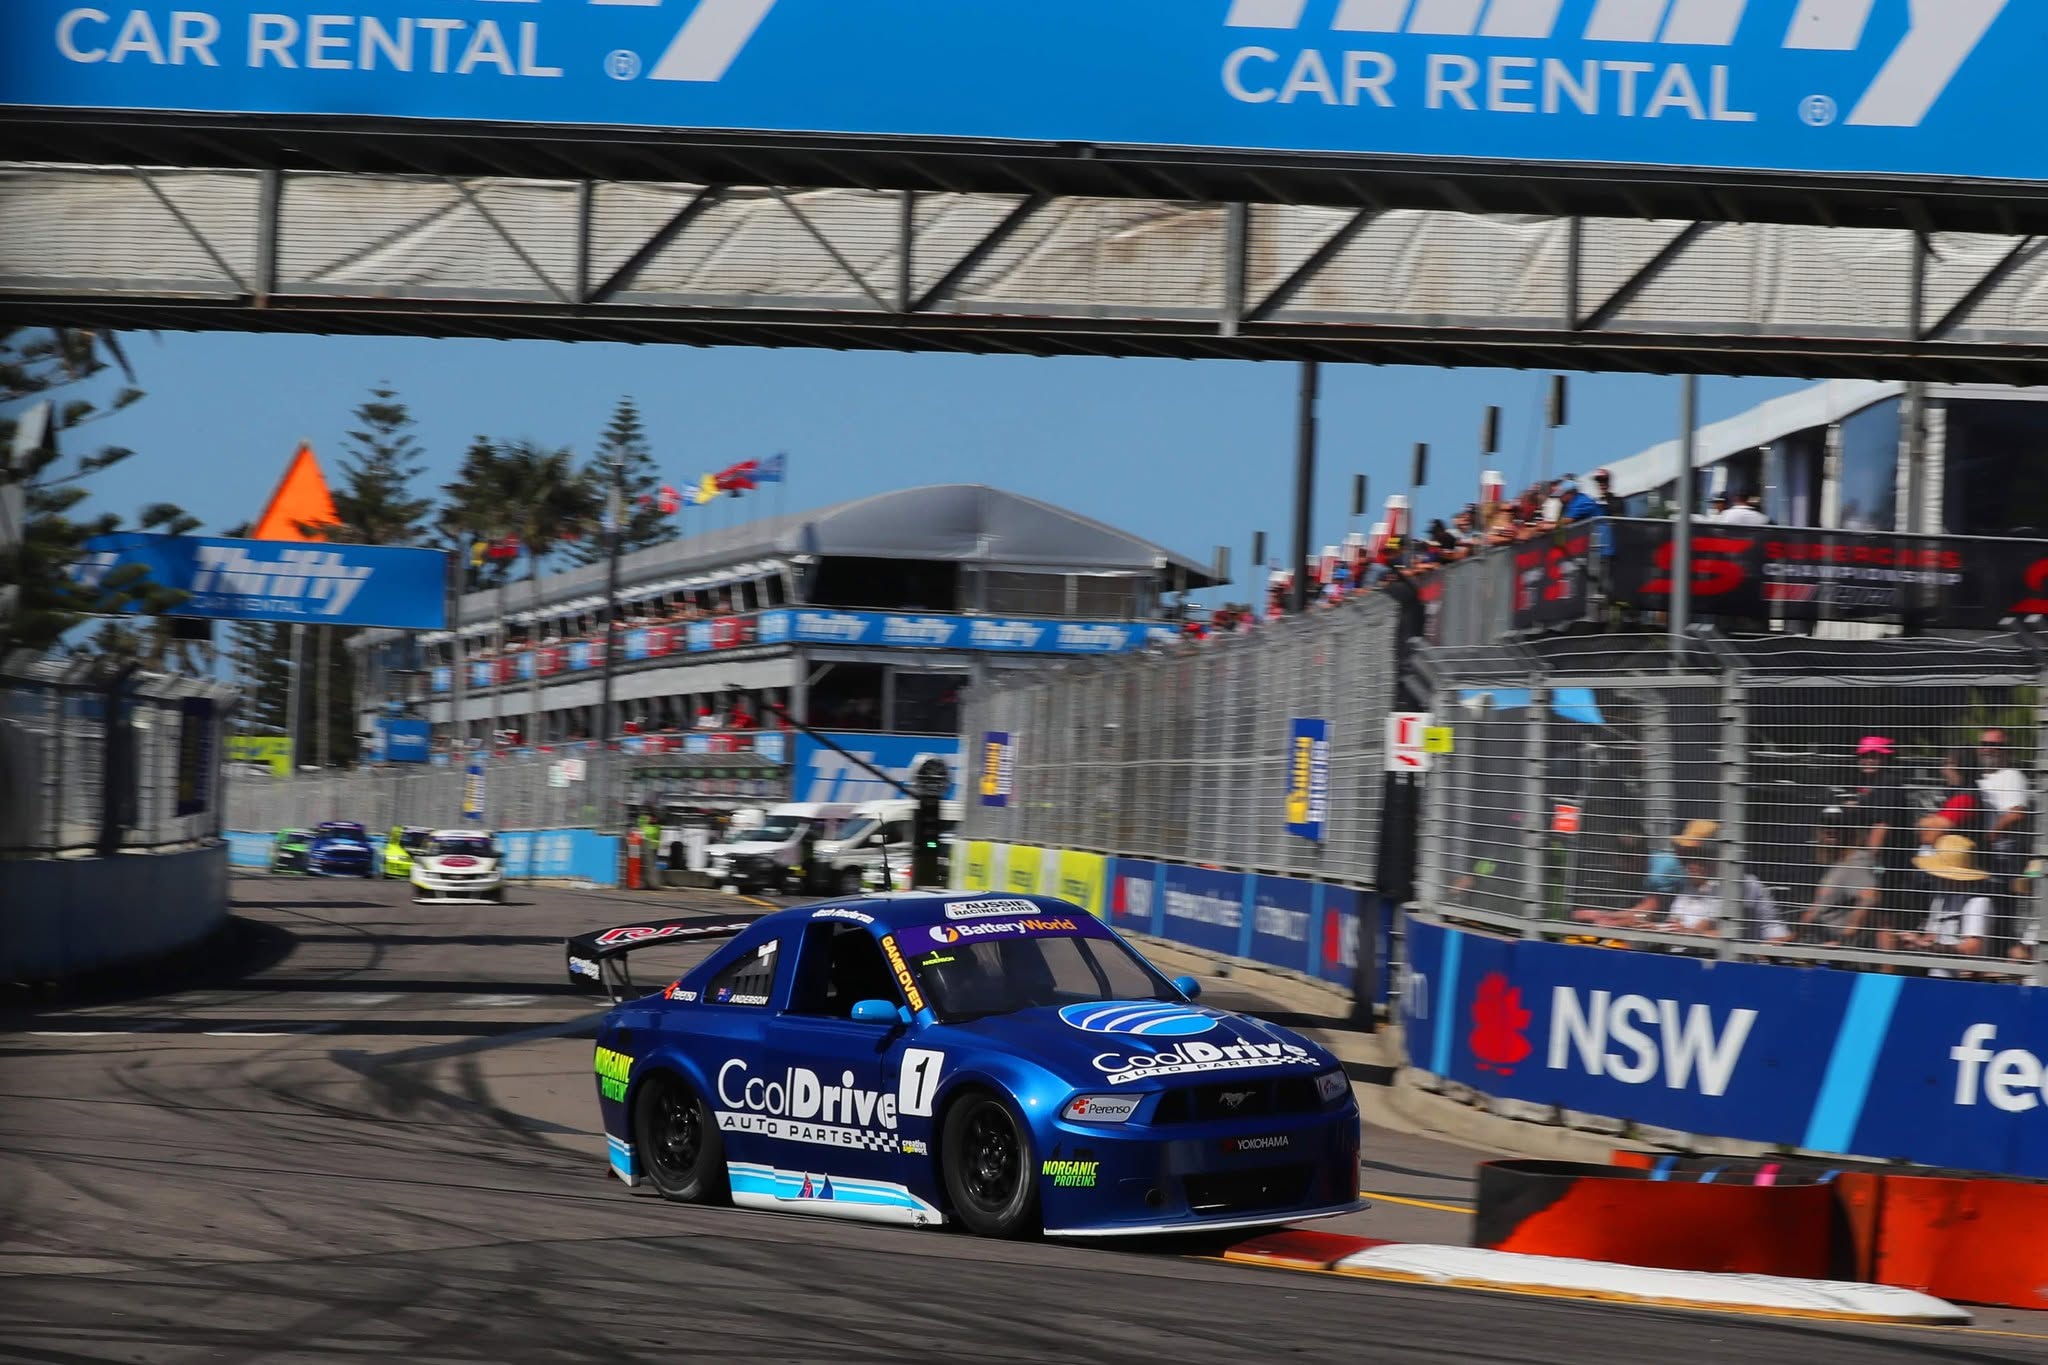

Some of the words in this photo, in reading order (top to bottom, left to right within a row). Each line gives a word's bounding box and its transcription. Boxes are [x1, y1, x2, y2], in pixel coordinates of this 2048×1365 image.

[56, 8, 220, 67] CAR
[246, 13, 564, 78] RENTAL
[1222, 46, 1397, 107] CAR
[1425, 53, 1757, 122] RENTAL
[1764, 541, 1961, 569] SUPERCARS
[193, 546, 375, 615] Thrifty
[1761, 562, 1963, 585] CHAMPIONSHIP
[954, 906, 999, 916] RACING
[1002, 905, 1033, 913] CARS
[965, 900, 1028, 910] AUSSIE
[729, 993, 769, 1005] ANDERSON
[1547, 985, 1759, 1096] NSW
[1092, 1037, 1308, 1073] CoolDrive
[915, 1056, 931, 1109] 1
[1117, 1065, 1183, 1082] AUTO
[1198, 1057, 1269, 1070] PARTS
[717, 1058, 898, 1130] CoolDrive
[1088, 1102, 1131, 1115] Perenso
[723, 1115, 778, 1134] AUTO
[789, 1125, 852, 1144] PARTS
[1237, 1135, 1289, 1150] YOKOHAMA
[1042, 1160, 1099, 1176] NORGANIC
[1053, 1174, 1097, 1187] PROTEINS
